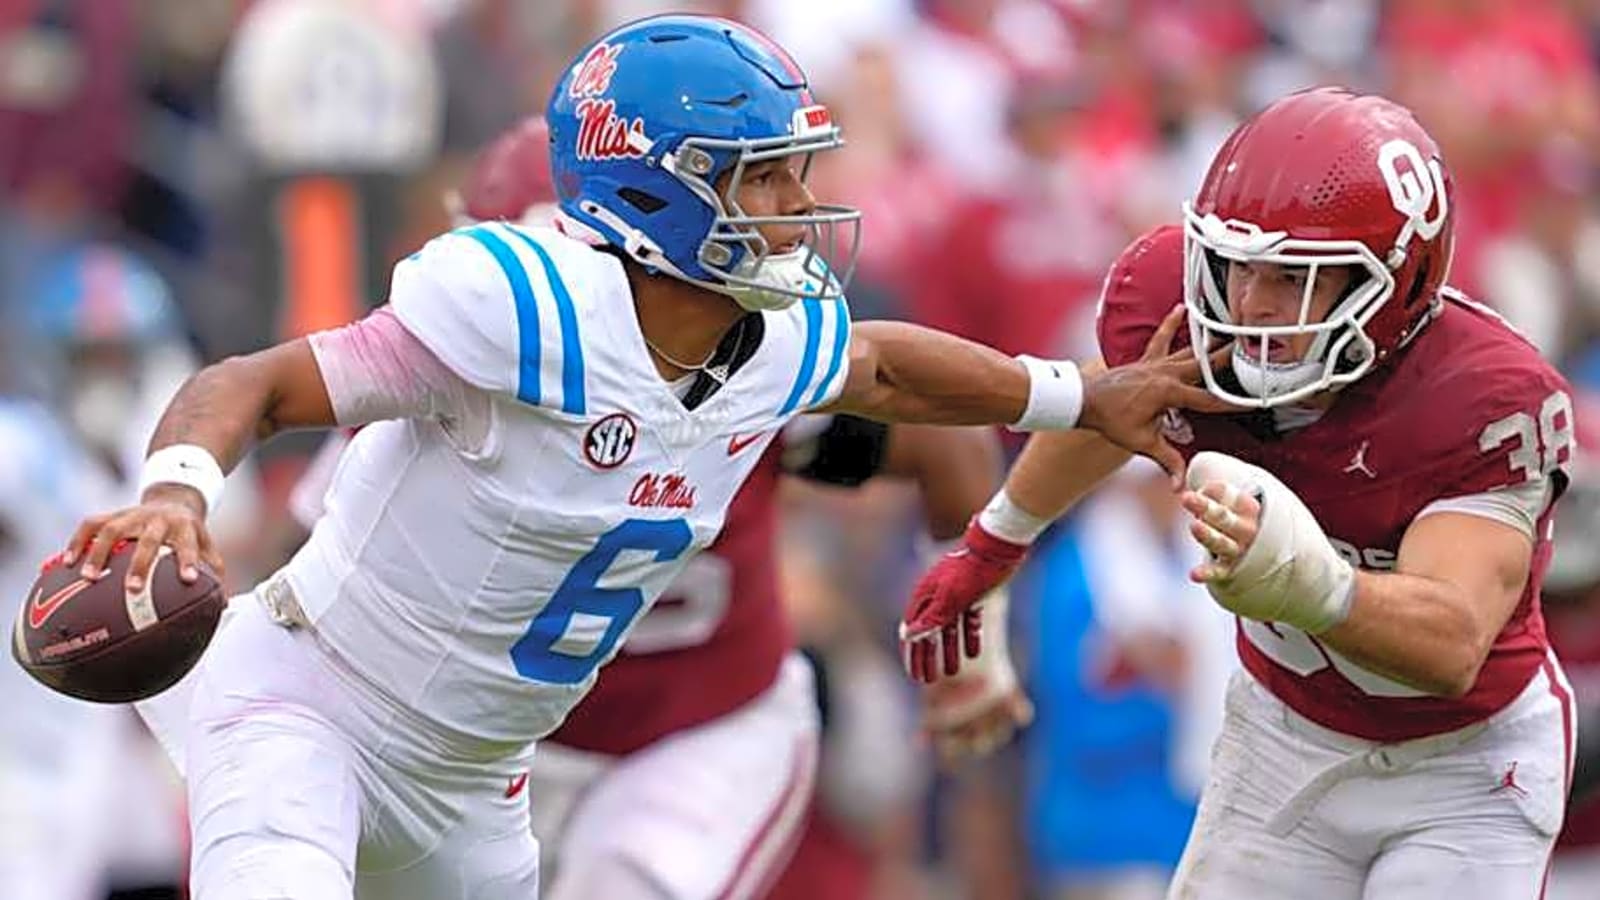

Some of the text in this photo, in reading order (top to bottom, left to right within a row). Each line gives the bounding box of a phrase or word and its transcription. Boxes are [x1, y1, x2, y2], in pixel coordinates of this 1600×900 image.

[570, 42, 624, 98] Ole
[1377, 140, 1448, 241] OU
[588, 418, 633, 463] SEC
[1478, 389, 1577, 484] 38
[628, 472, 697, 508] Ole Miss
[509, 518, 693, 684] 6
